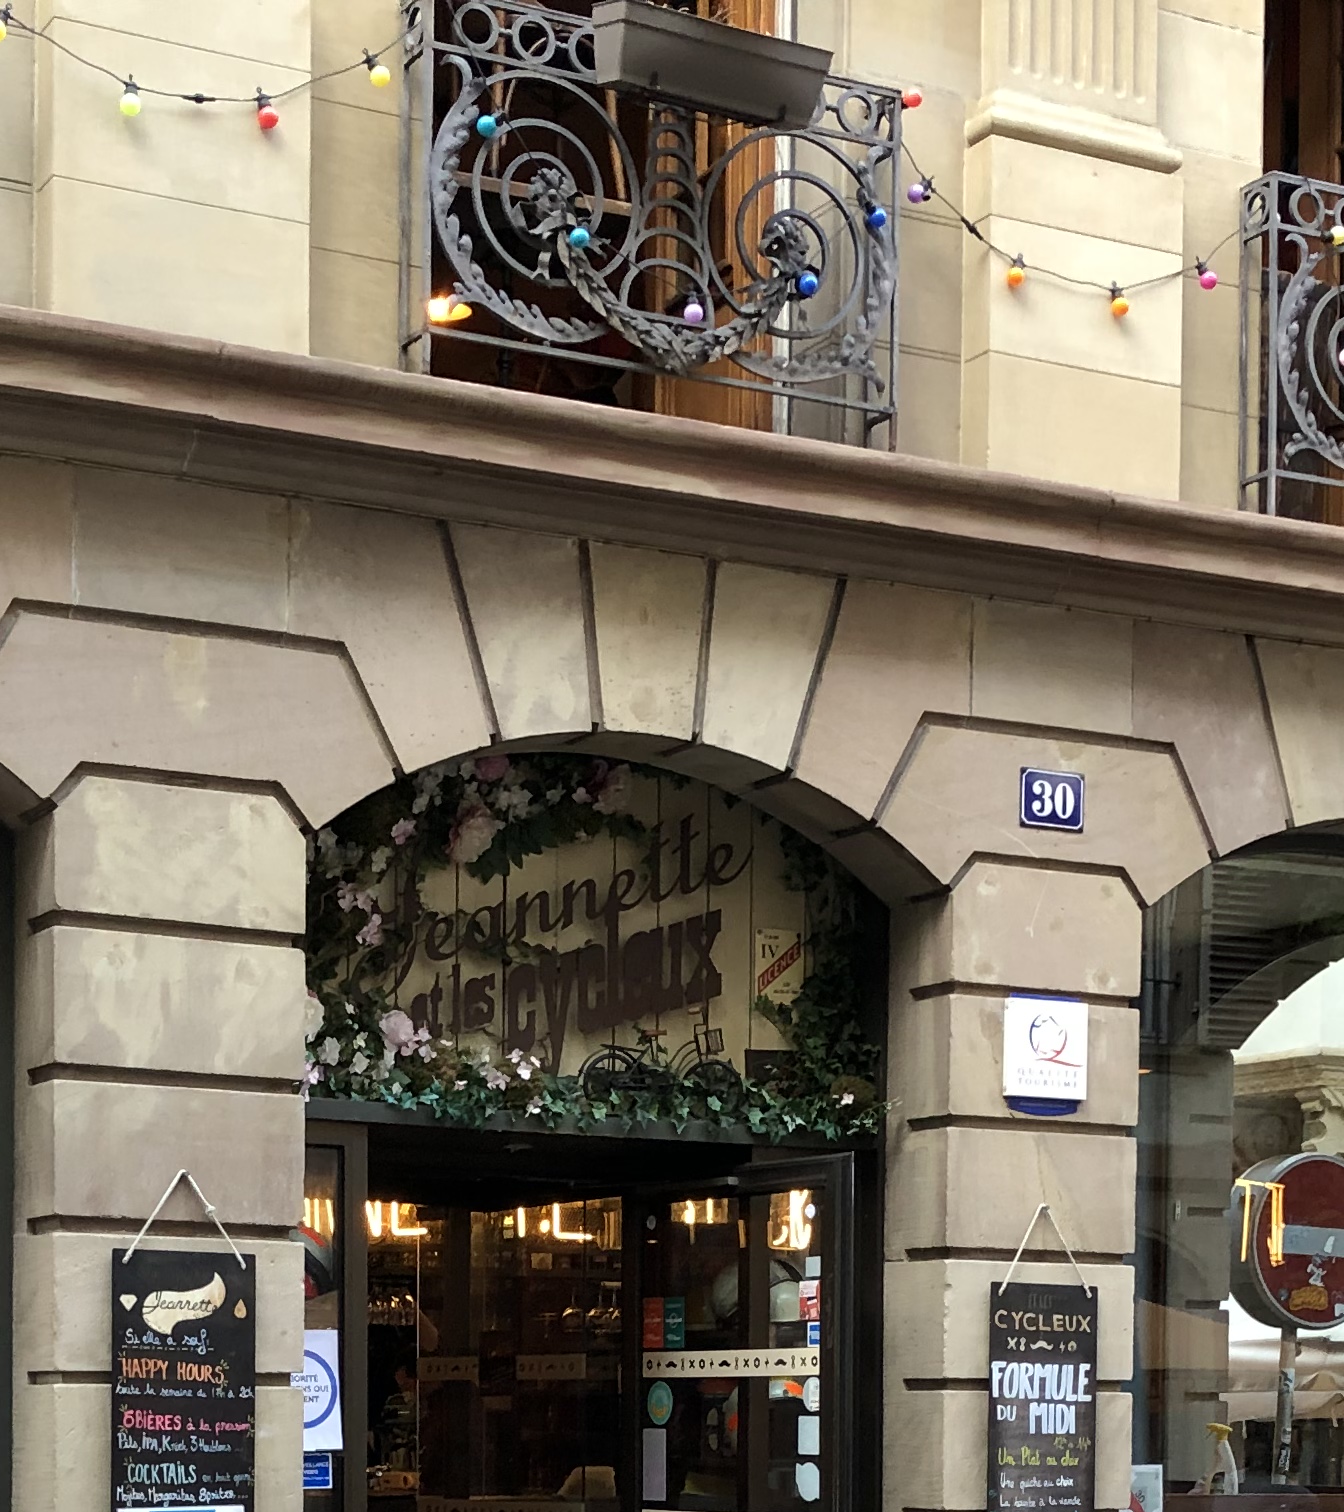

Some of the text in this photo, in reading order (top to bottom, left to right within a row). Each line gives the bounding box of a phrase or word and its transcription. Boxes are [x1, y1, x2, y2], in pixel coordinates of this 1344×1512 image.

[1031, 779, 1075, 820] 30
[353, 812, 754, 1003] Jeannette
[758, 942, 801, 994] LICENCE
[507, 908, 722, 1077] cycleux
[994, 1309, 1091, 1332] CYCLEUX
[122, 1358, 224, 1384] HAPPY HOURS
[991, 1360, 1092, 1402] FORMULE
[996, 1402, 1076, 1434] DU MIDI
[998, 1447, 1015, 1466] Un
